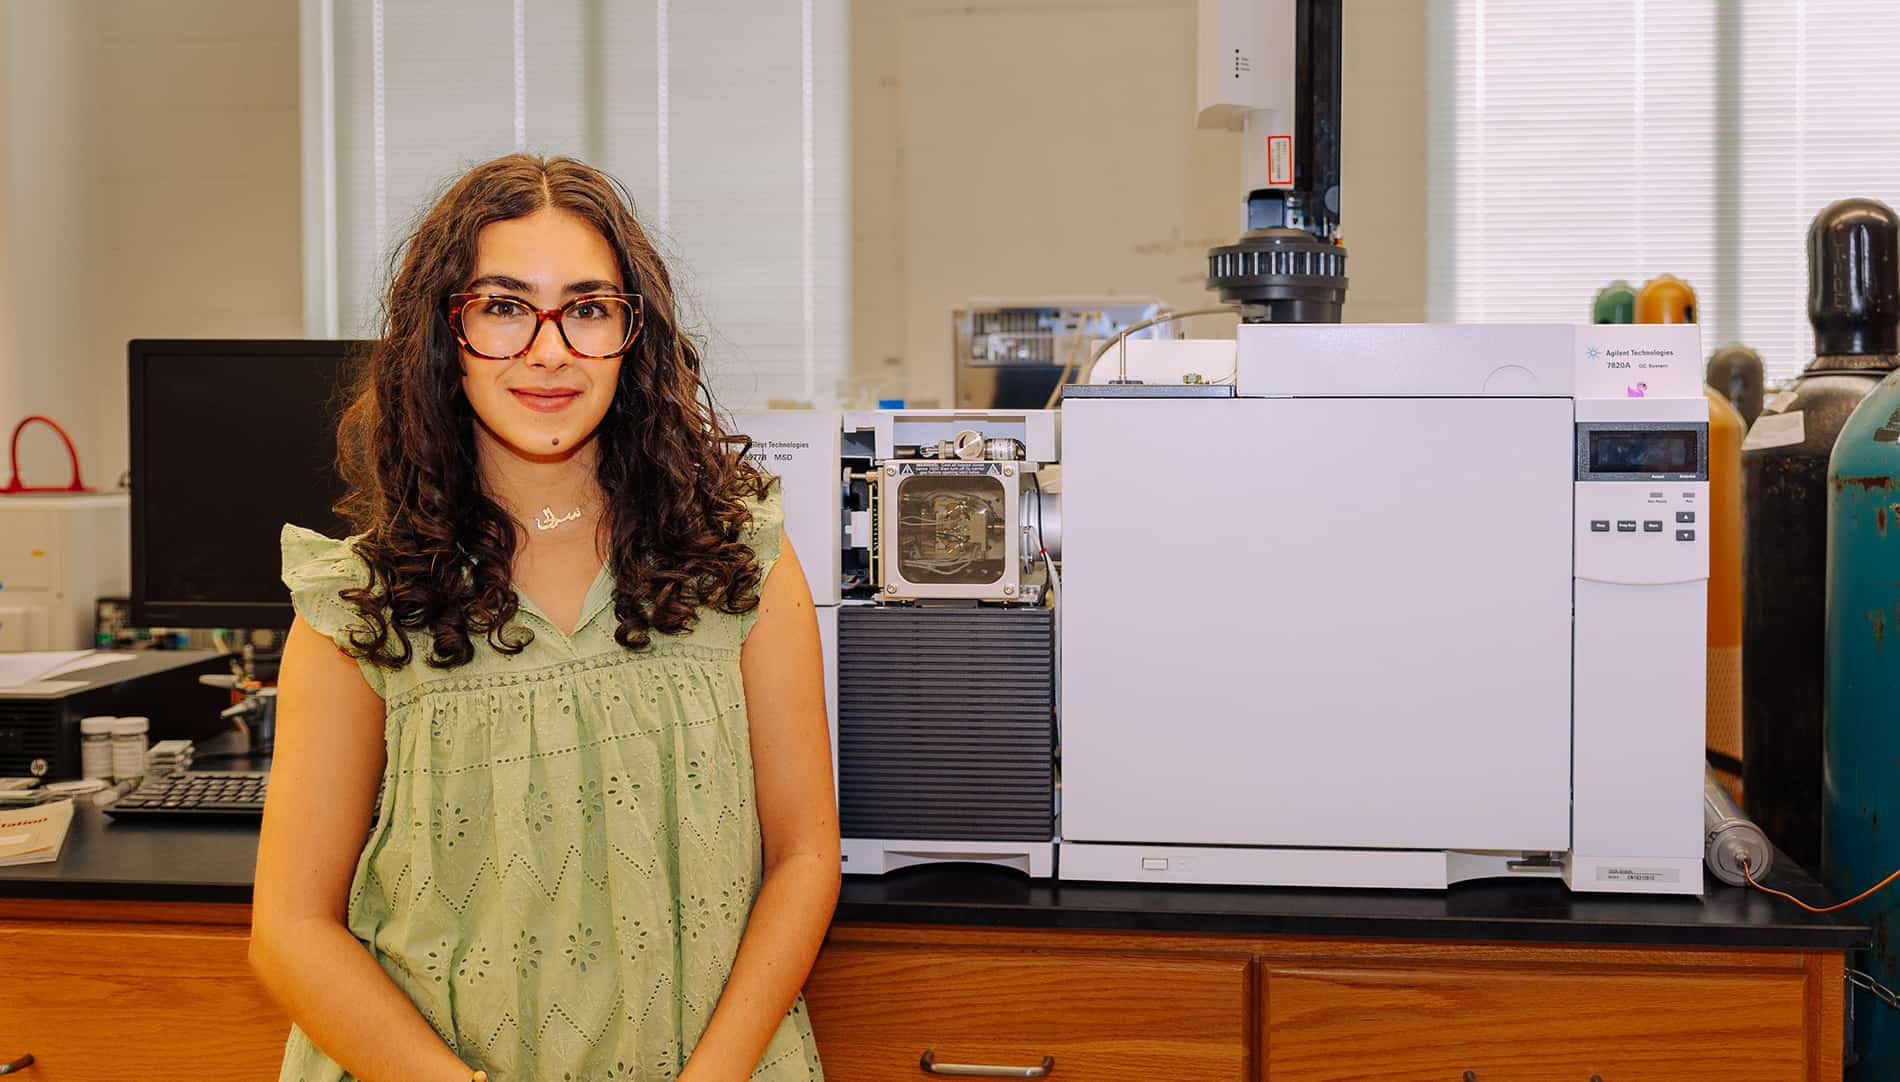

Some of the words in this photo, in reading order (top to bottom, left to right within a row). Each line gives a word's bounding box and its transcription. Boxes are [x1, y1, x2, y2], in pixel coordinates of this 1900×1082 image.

[1631, 349, 1674, 357] Technologies
[768, 441, 809, 449] Technologies
[774, 453, 793, 461] MSD
